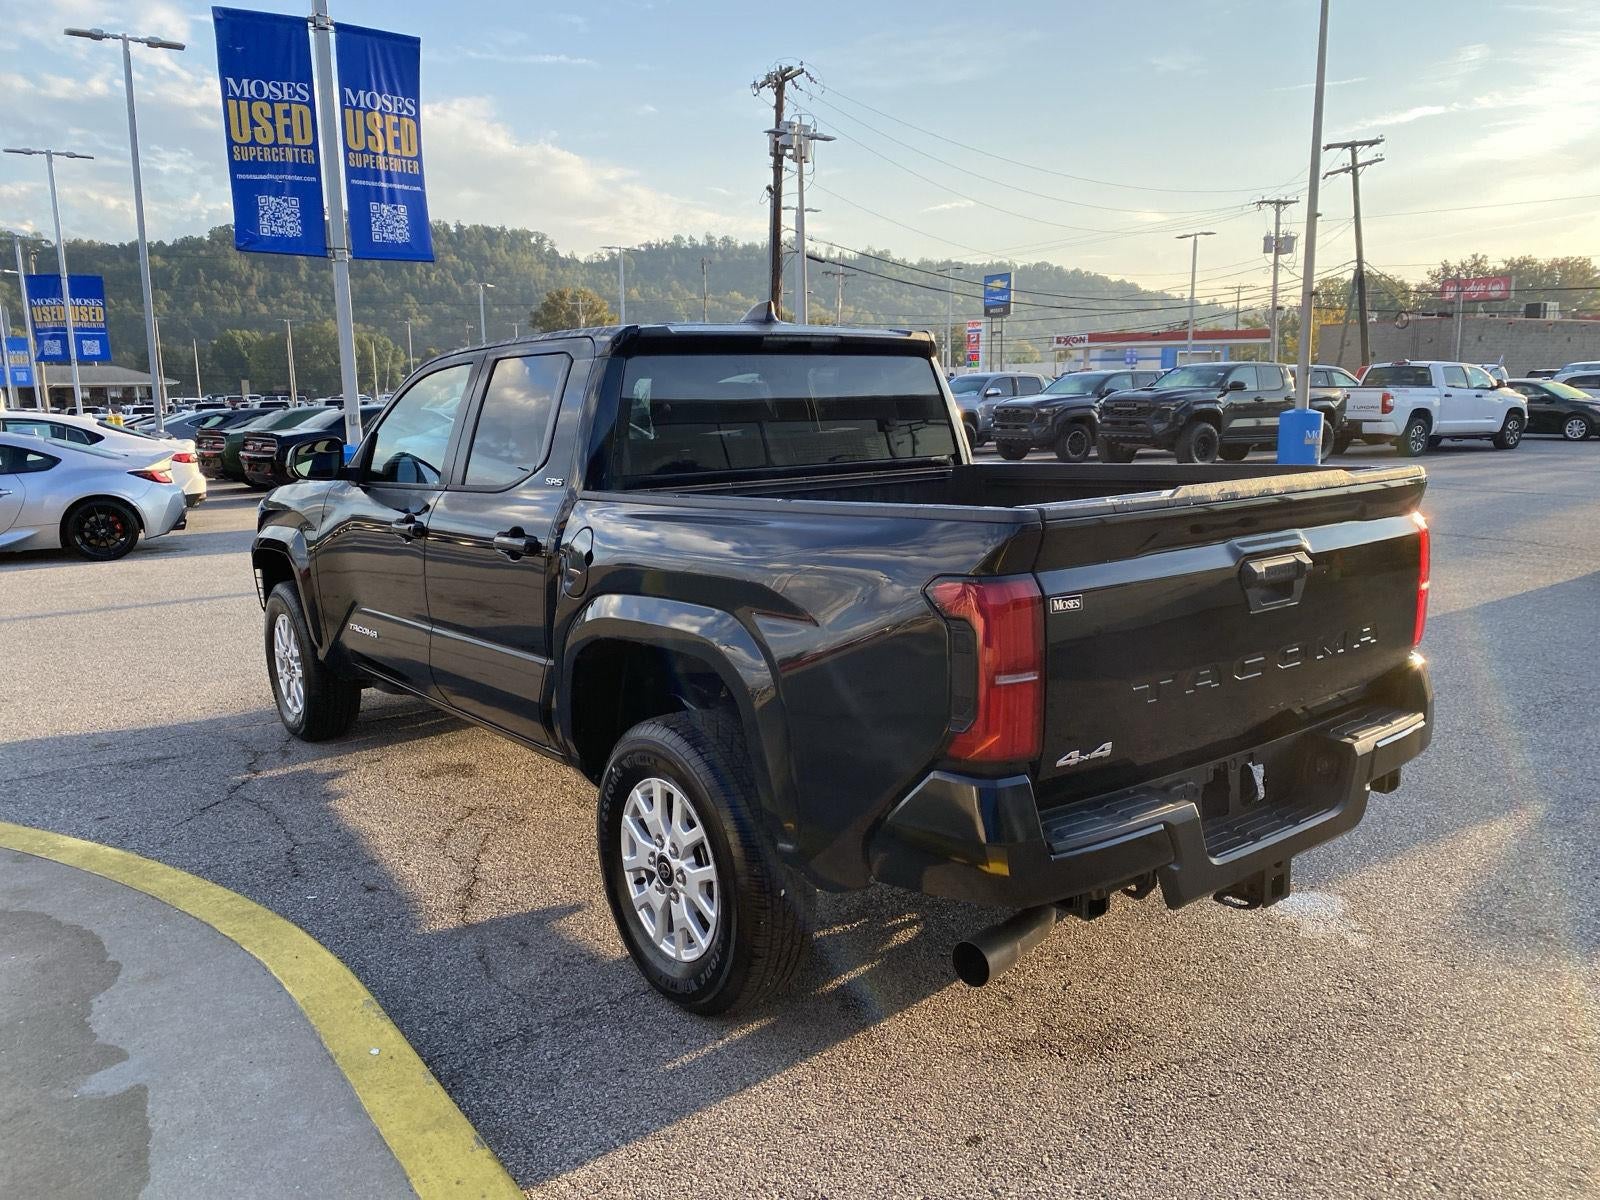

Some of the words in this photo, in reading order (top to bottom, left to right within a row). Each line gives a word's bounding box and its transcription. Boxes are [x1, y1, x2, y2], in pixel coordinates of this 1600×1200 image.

[225, 77, 310, 102] MOSES
[344, 88, 415, 116] MOSES
[228, 99, 313, 145] USED
[345, 109, 418, 157] USED
[233, 145, 315, 165] SUPERCENTER
[348, 156, 419, 175] SUPERCENTER
[236, 173, 317, 183] mosesusedsupercenter.com
[31, 298, 64, 306] MOSES
[70, 298, 103, 306] MOSES
[32, 306, 65, 321] USED
[70, 306, 104, 321] USED
[1056, 336, 1086, 346] EXXON
[1053, 598, 1080, 611] MOSES
[349, 622, 378, 639] TACOMA
[1133, 623, 1378, 703] TACOMA
[1056, 741, 1113, 767] 4x4
